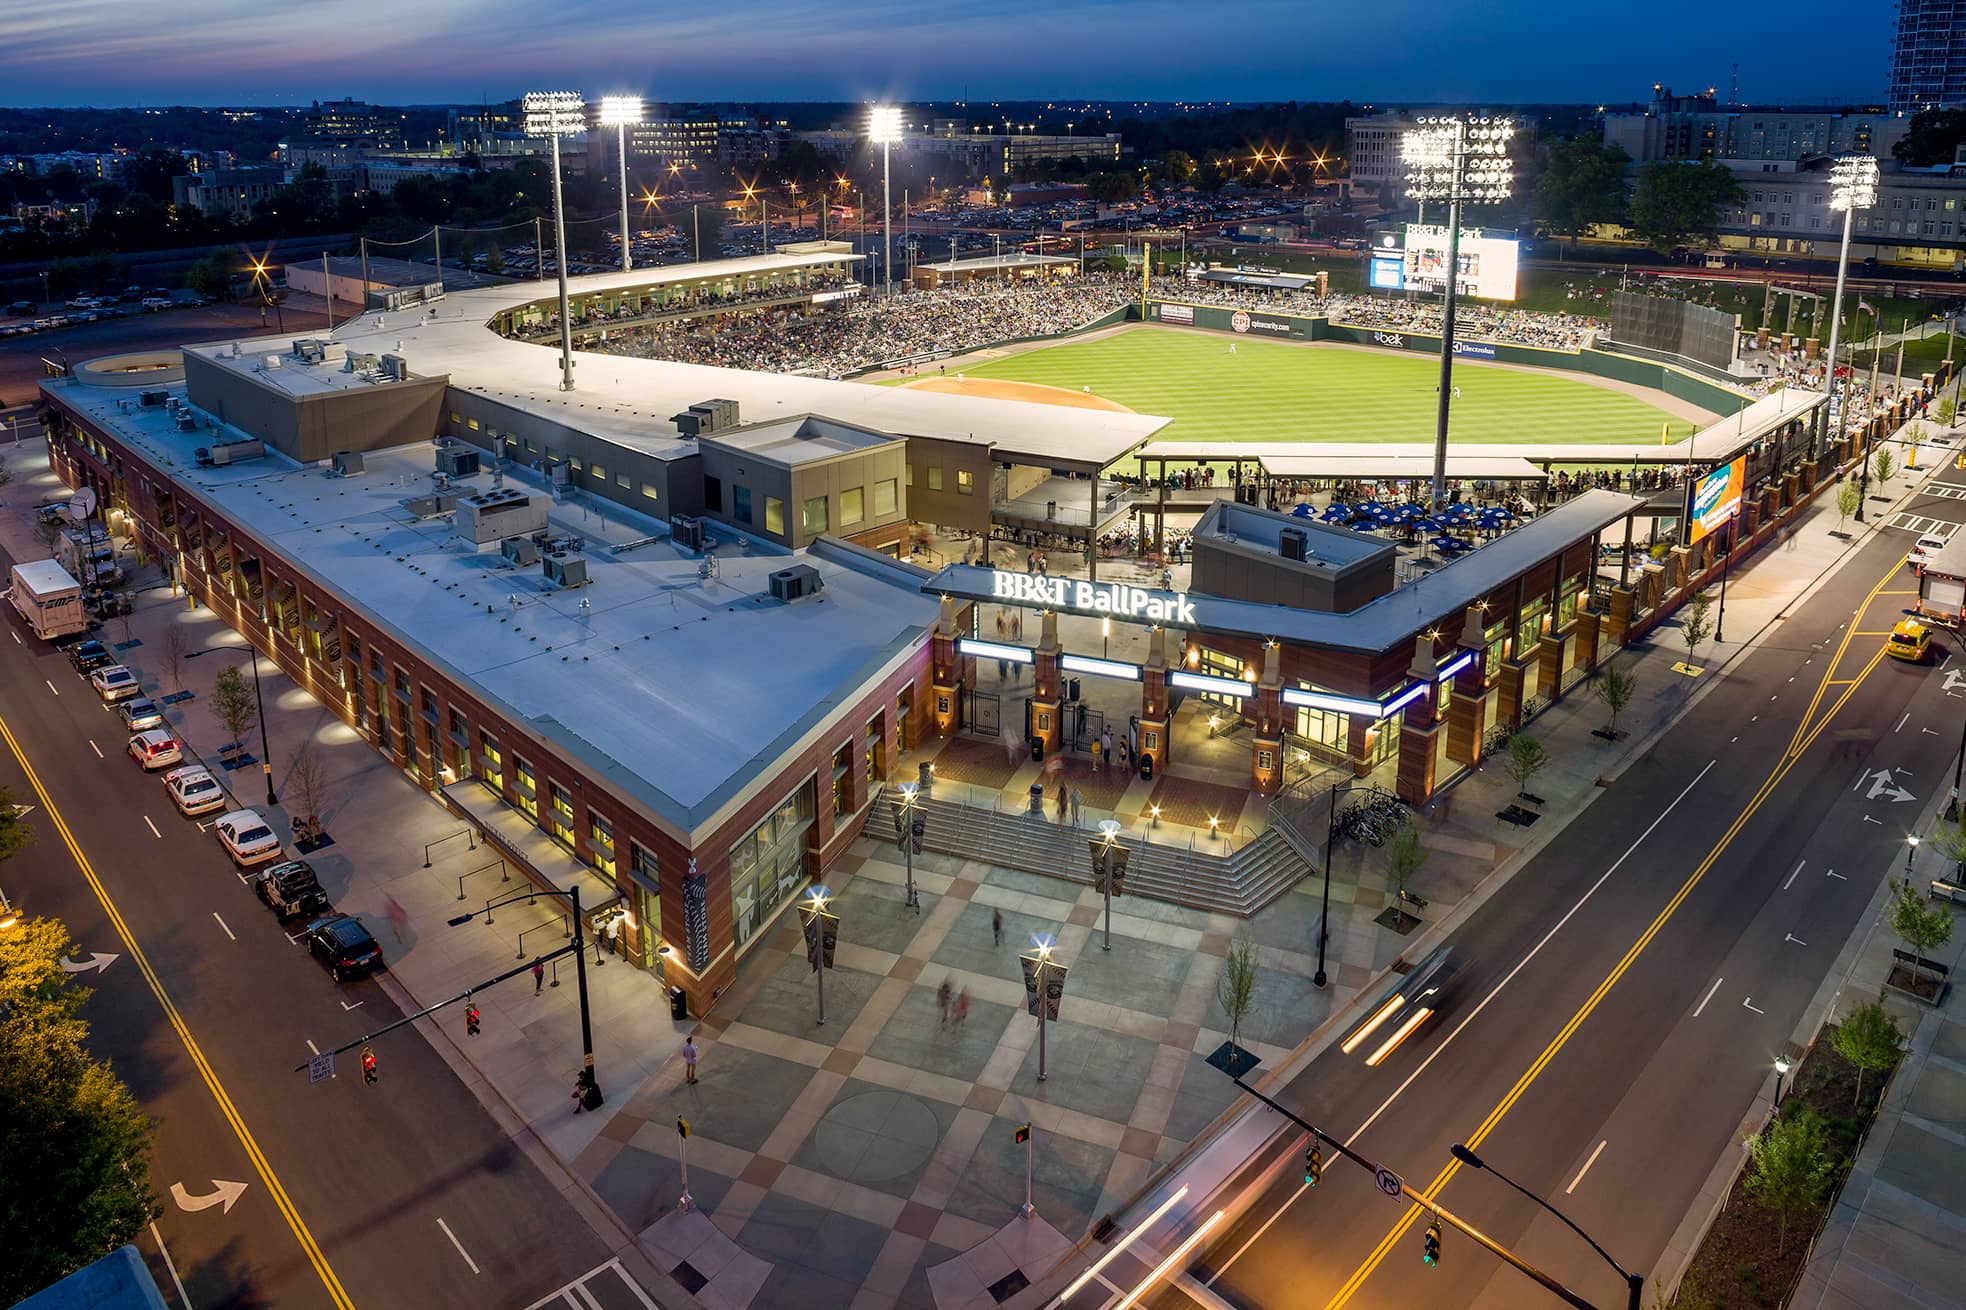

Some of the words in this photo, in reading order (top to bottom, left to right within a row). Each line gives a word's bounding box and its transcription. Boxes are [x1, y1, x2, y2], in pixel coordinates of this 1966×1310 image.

[1407, 223, 1437, 236] BB&T
[1437, 225, 1483, 239] BaPark
[1251, 319, 1290, 331] cpisecurity.com
[1380, 332, 1404, 346] belk
[1462, 345, 1495, 355] Electrolux
[992, 570, 1071, 606] BB&T
[1076, 581, 1196, 624] BallPark
